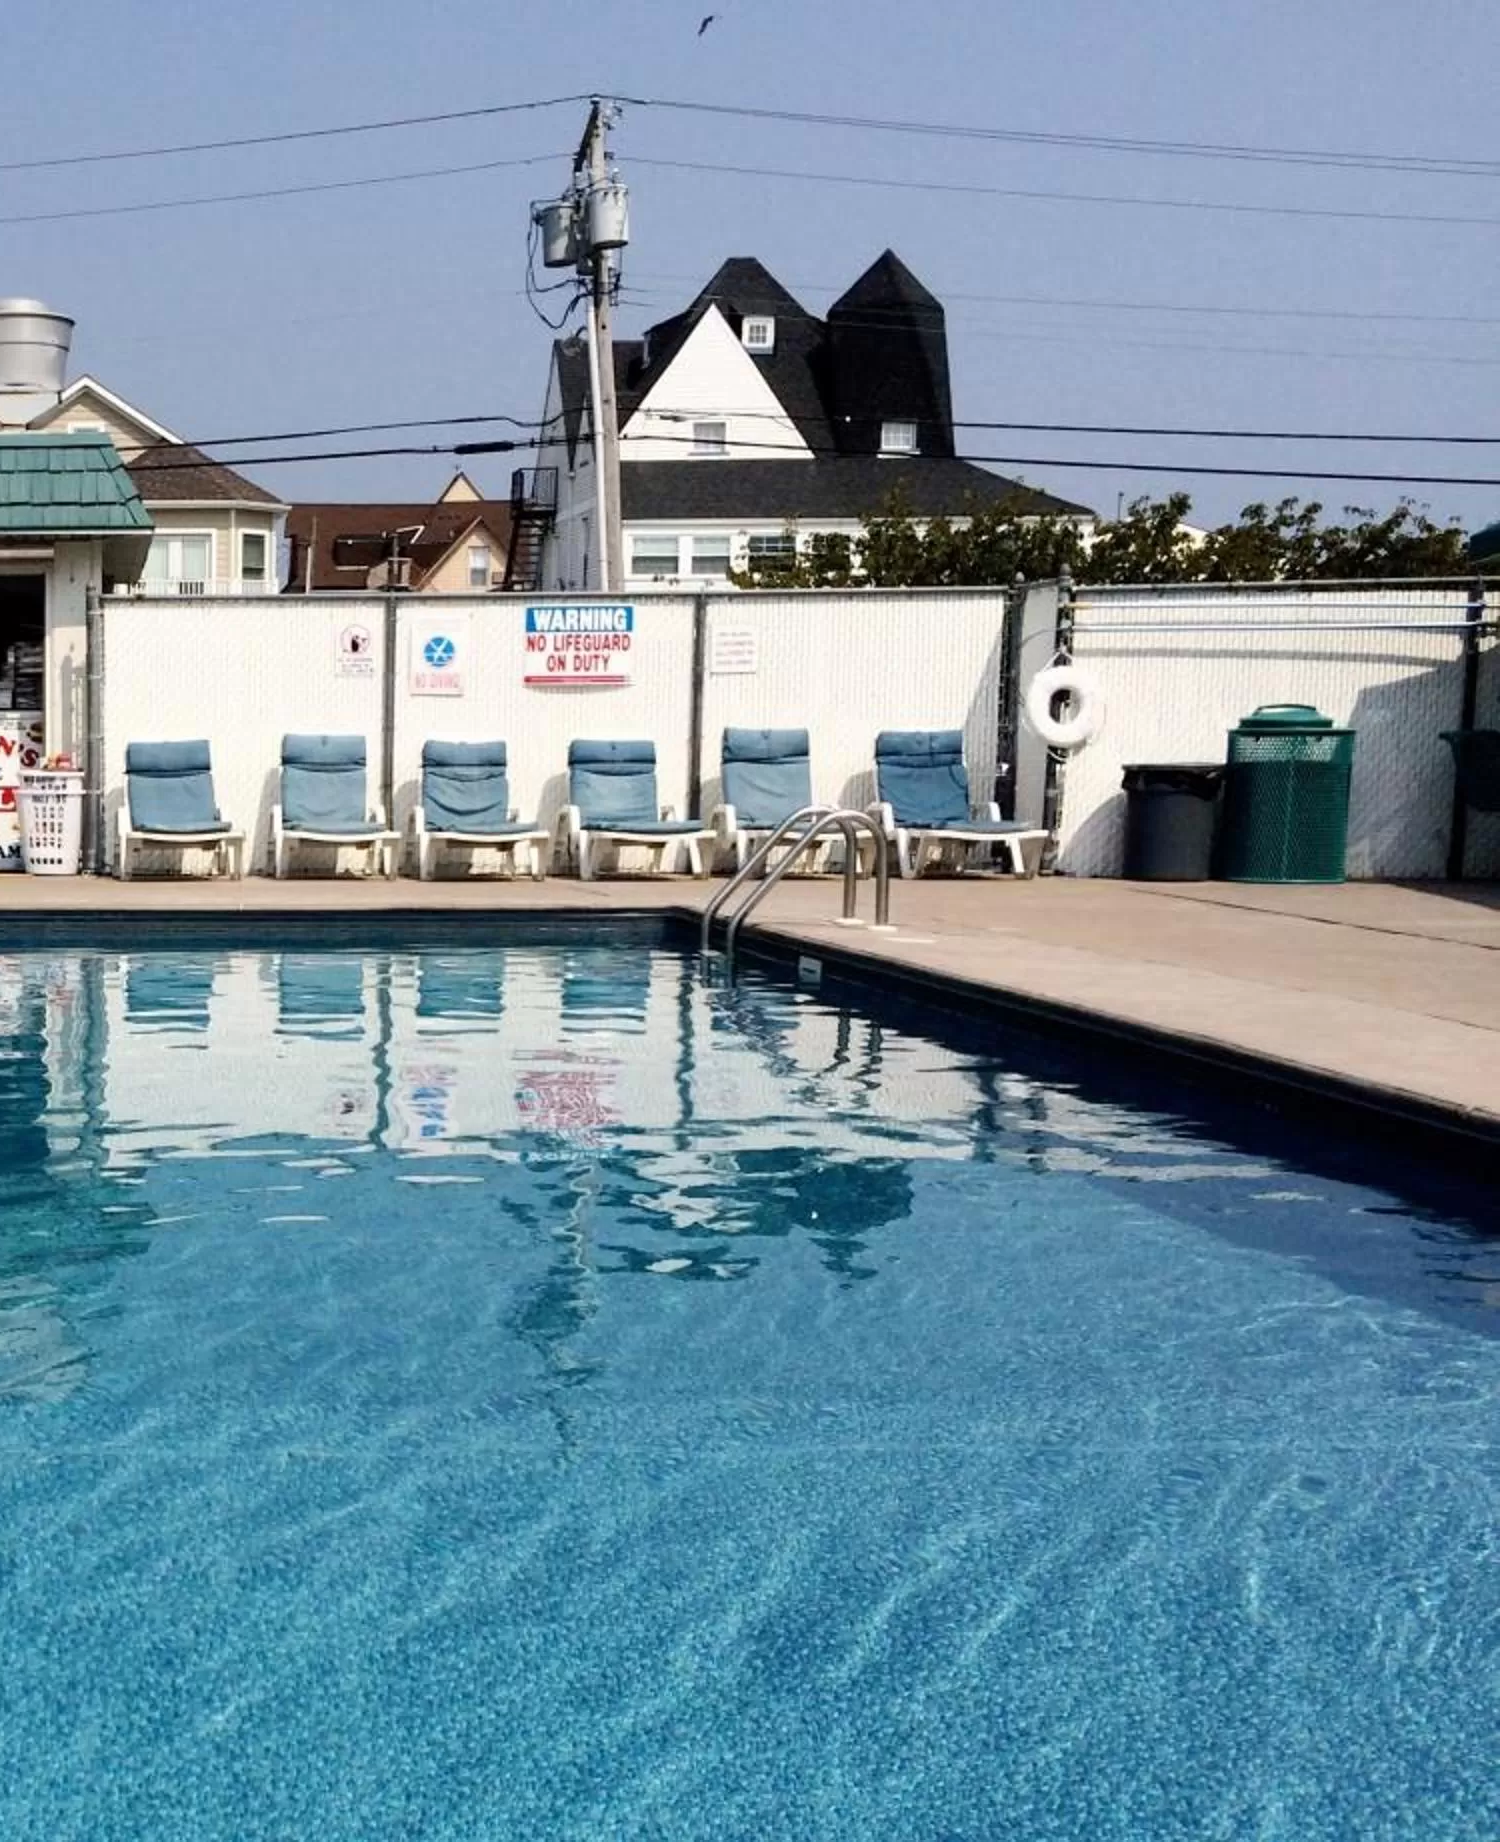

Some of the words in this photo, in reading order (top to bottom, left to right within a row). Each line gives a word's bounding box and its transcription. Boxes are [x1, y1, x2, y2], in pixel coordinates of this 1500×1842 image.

[532, 608, 628, 631] WARNING
[526, 634, 547, 652] NO
[553, 634, 631, 652] LIFEGUARD
[546, 654, 566, 672] ON
[573, 654, 610, 672] DUTY
